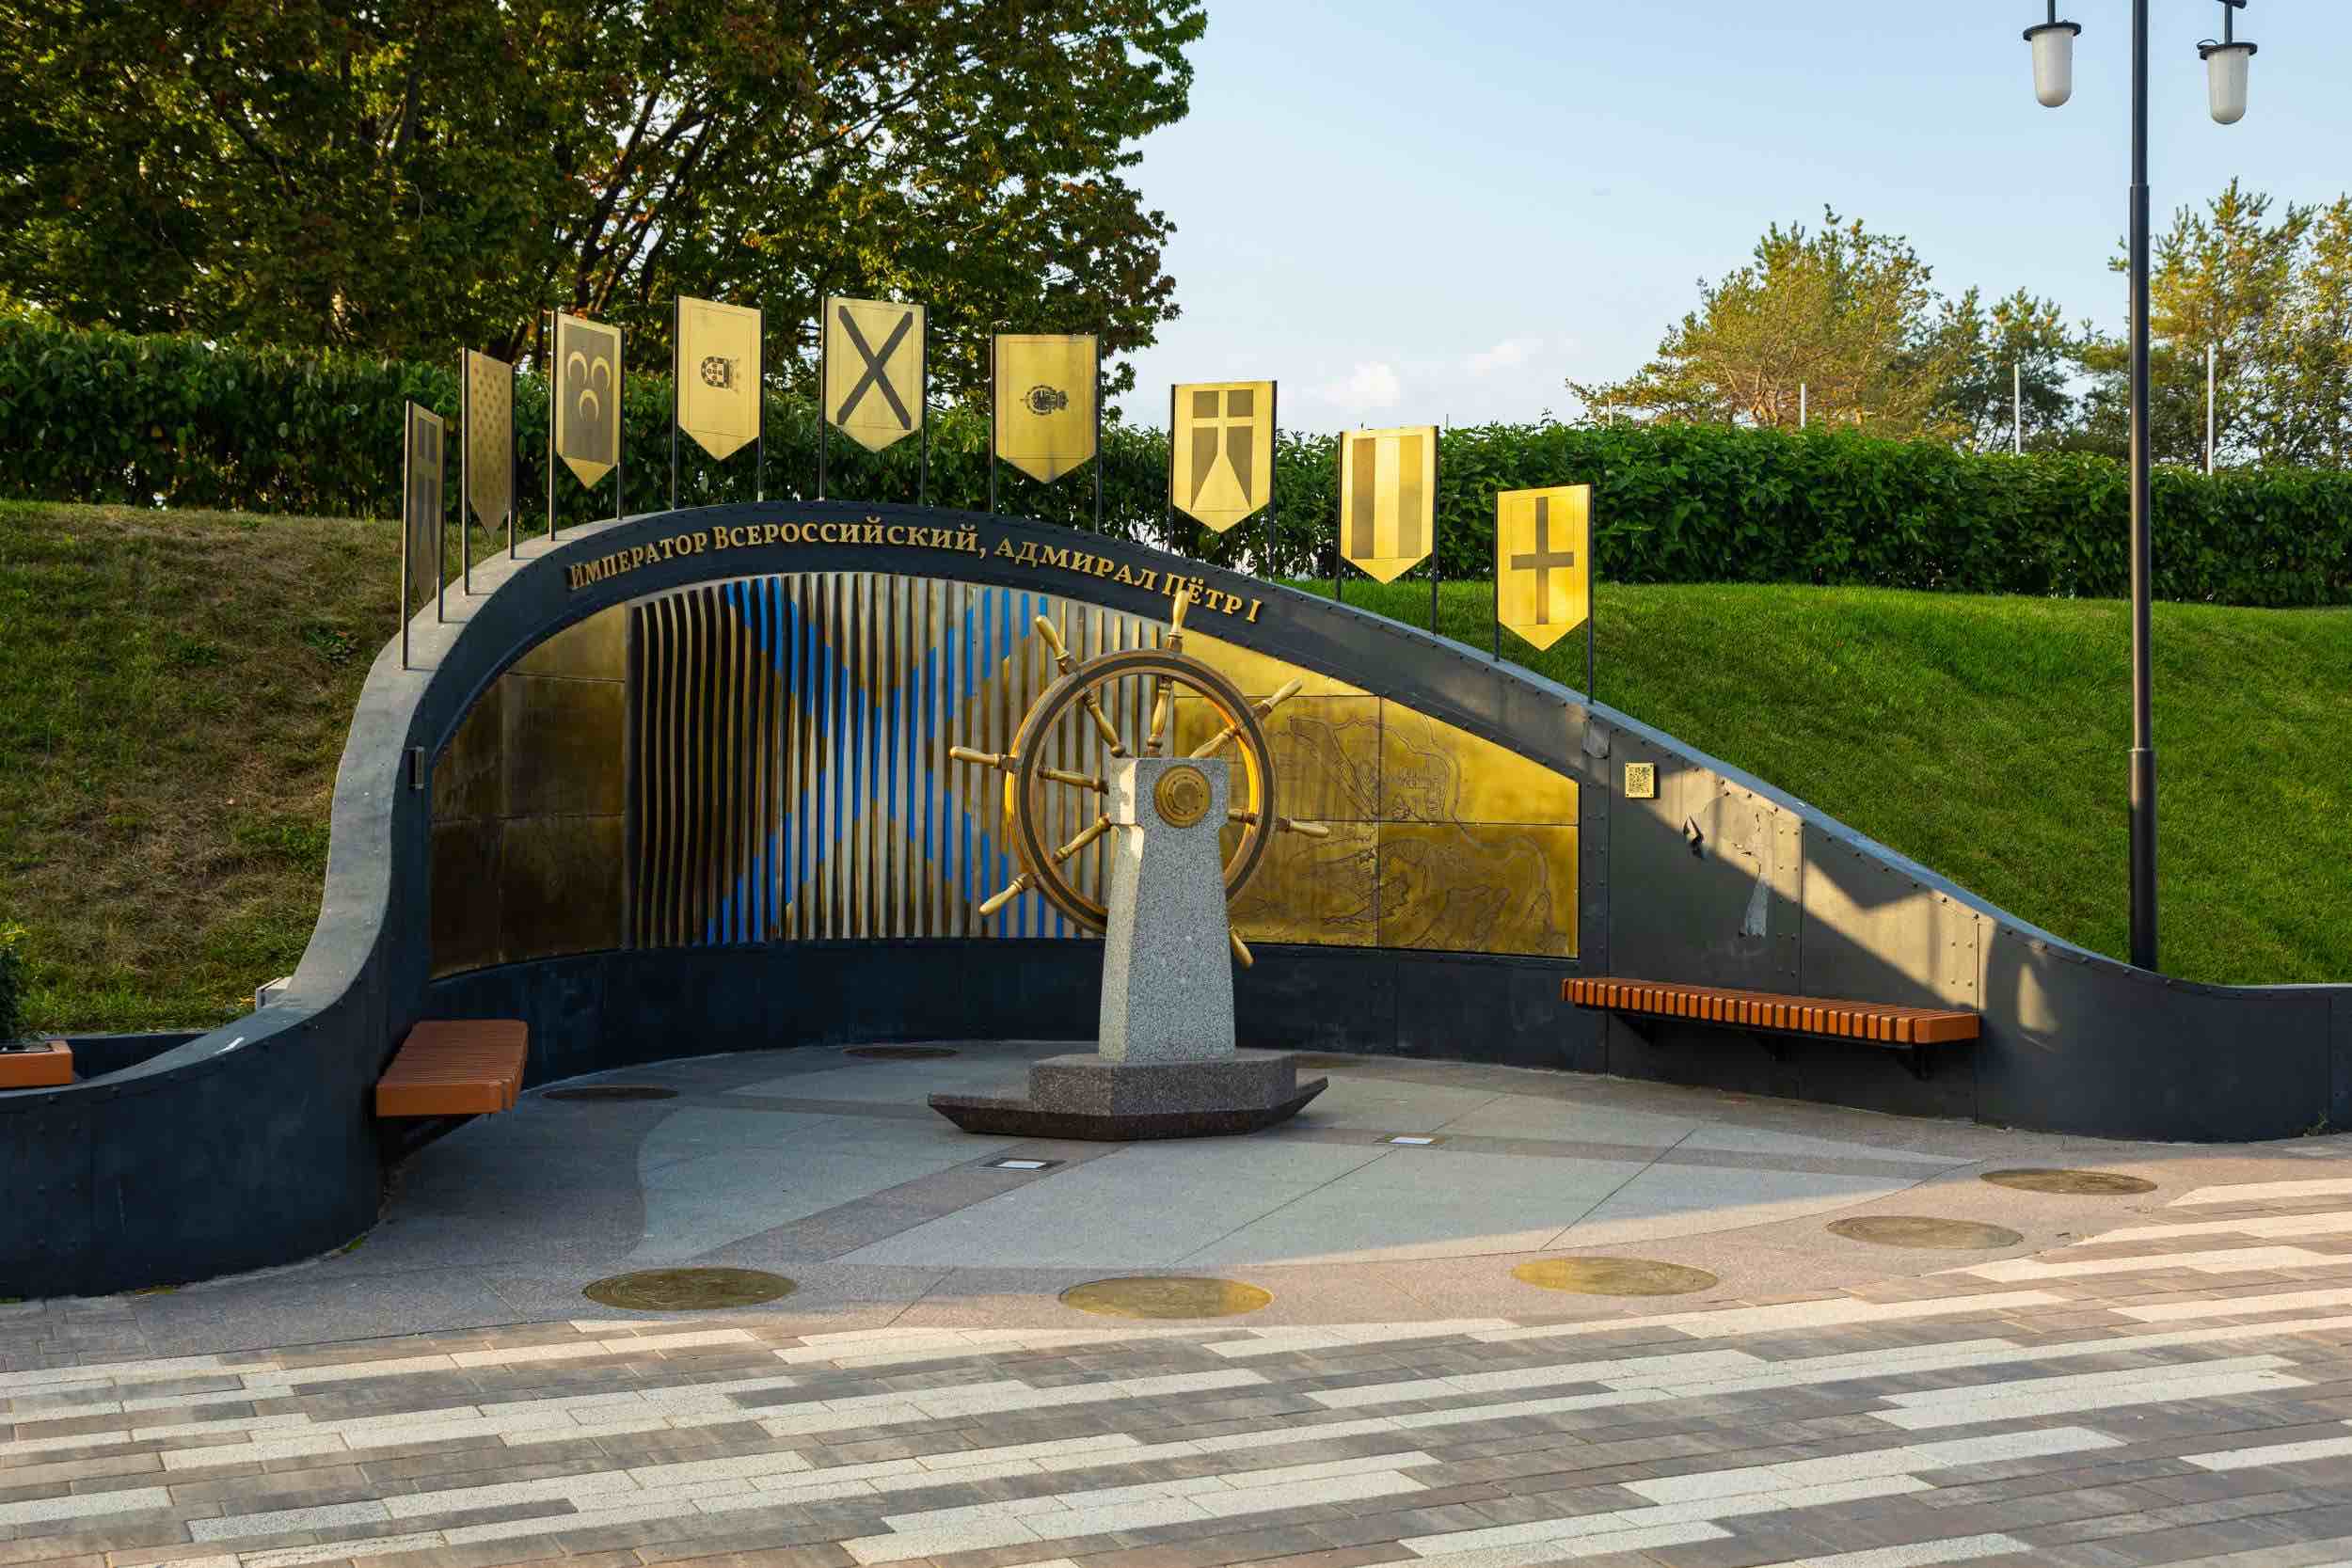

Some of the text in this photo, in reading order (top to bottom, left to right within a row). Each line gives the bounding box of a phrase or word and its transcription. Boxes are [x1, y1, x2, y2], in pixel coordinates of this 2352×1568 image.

[570, 531, 708, 590] ИМПЕРАТОР
[713, 515, 987, 560] ВСЕРОССИЙСКИЙ,
[993, 537, 1158, 591] АДМИРАЛ
[1162, 572, 1243, 615] ПЁТР
